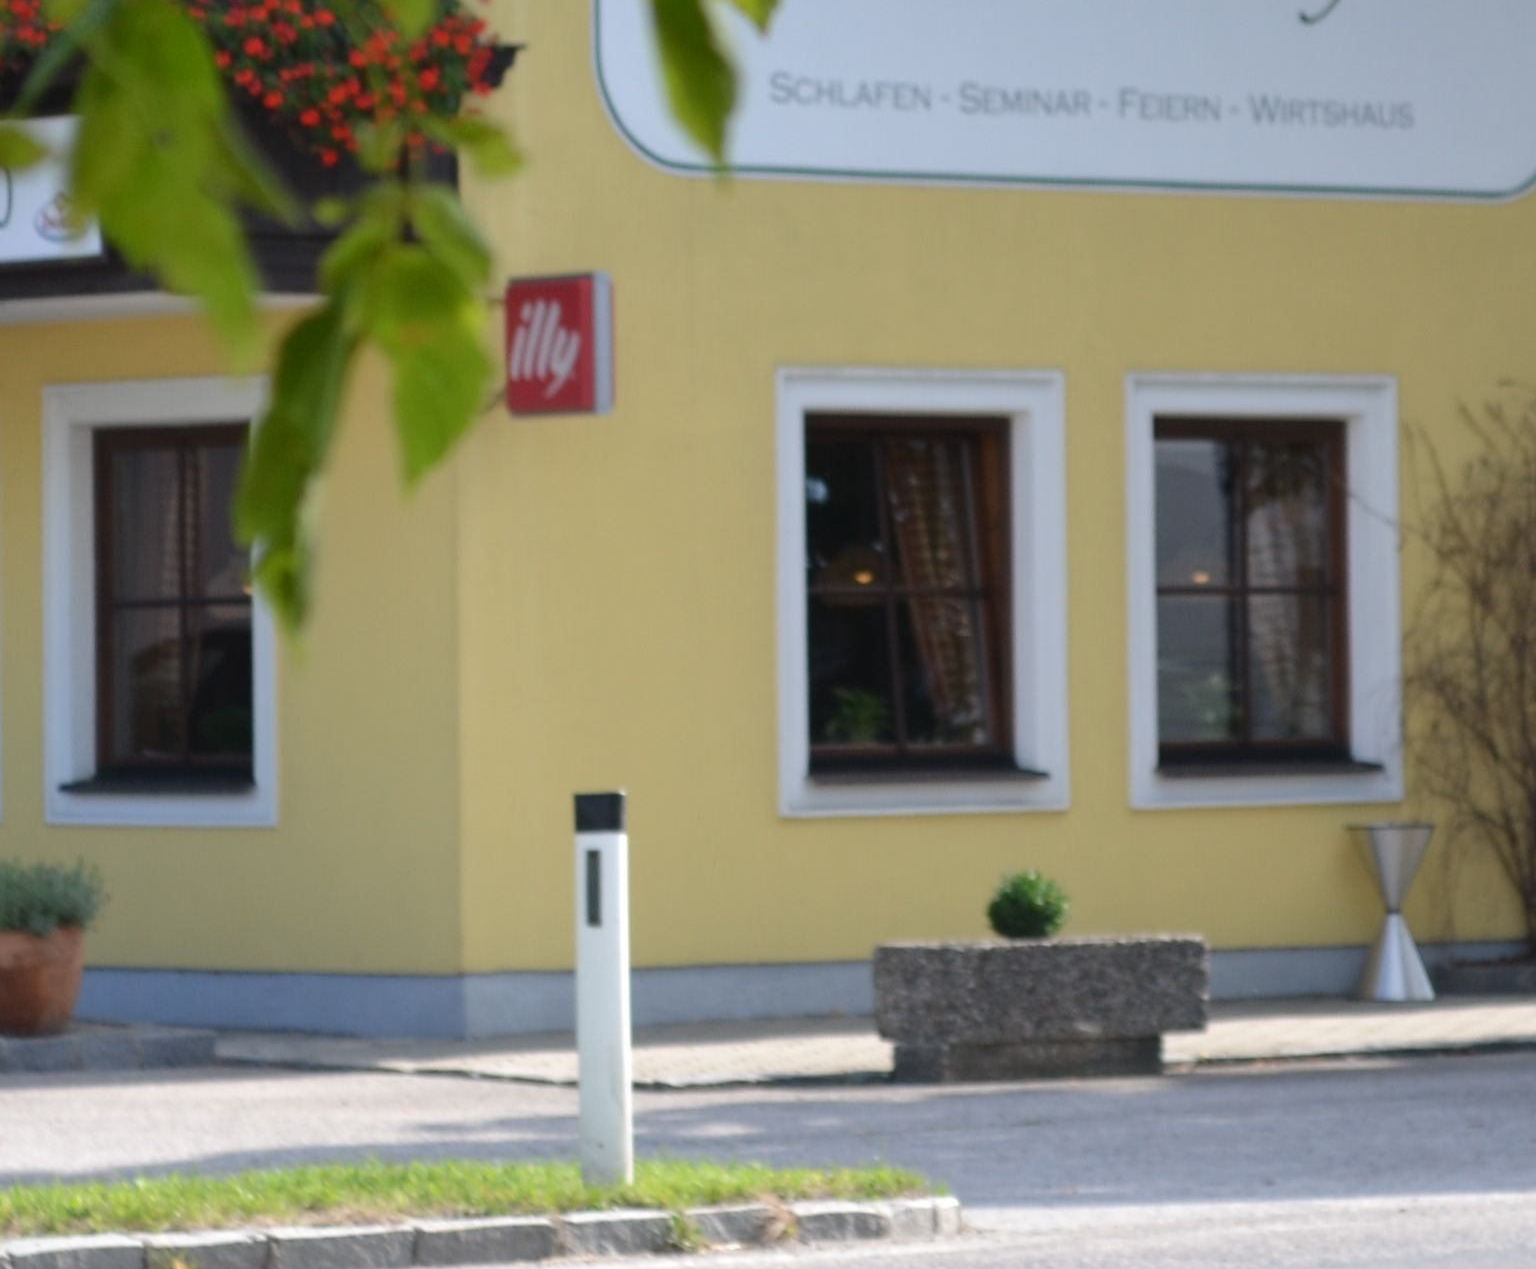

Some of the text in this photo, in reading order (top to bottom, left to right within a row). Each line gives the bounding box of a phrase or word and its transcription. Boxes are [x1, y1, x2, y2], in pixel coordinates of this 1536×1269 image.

[769, 69, 932, 111] SCHLAFEN
[958, 81, 1092, 118] SEMINAR
[1117, 85, 1222, 123] FEIERN
[1247, 92, 1415, 130] WIRTSHAUS
[510, 299, 581, 400] illy
